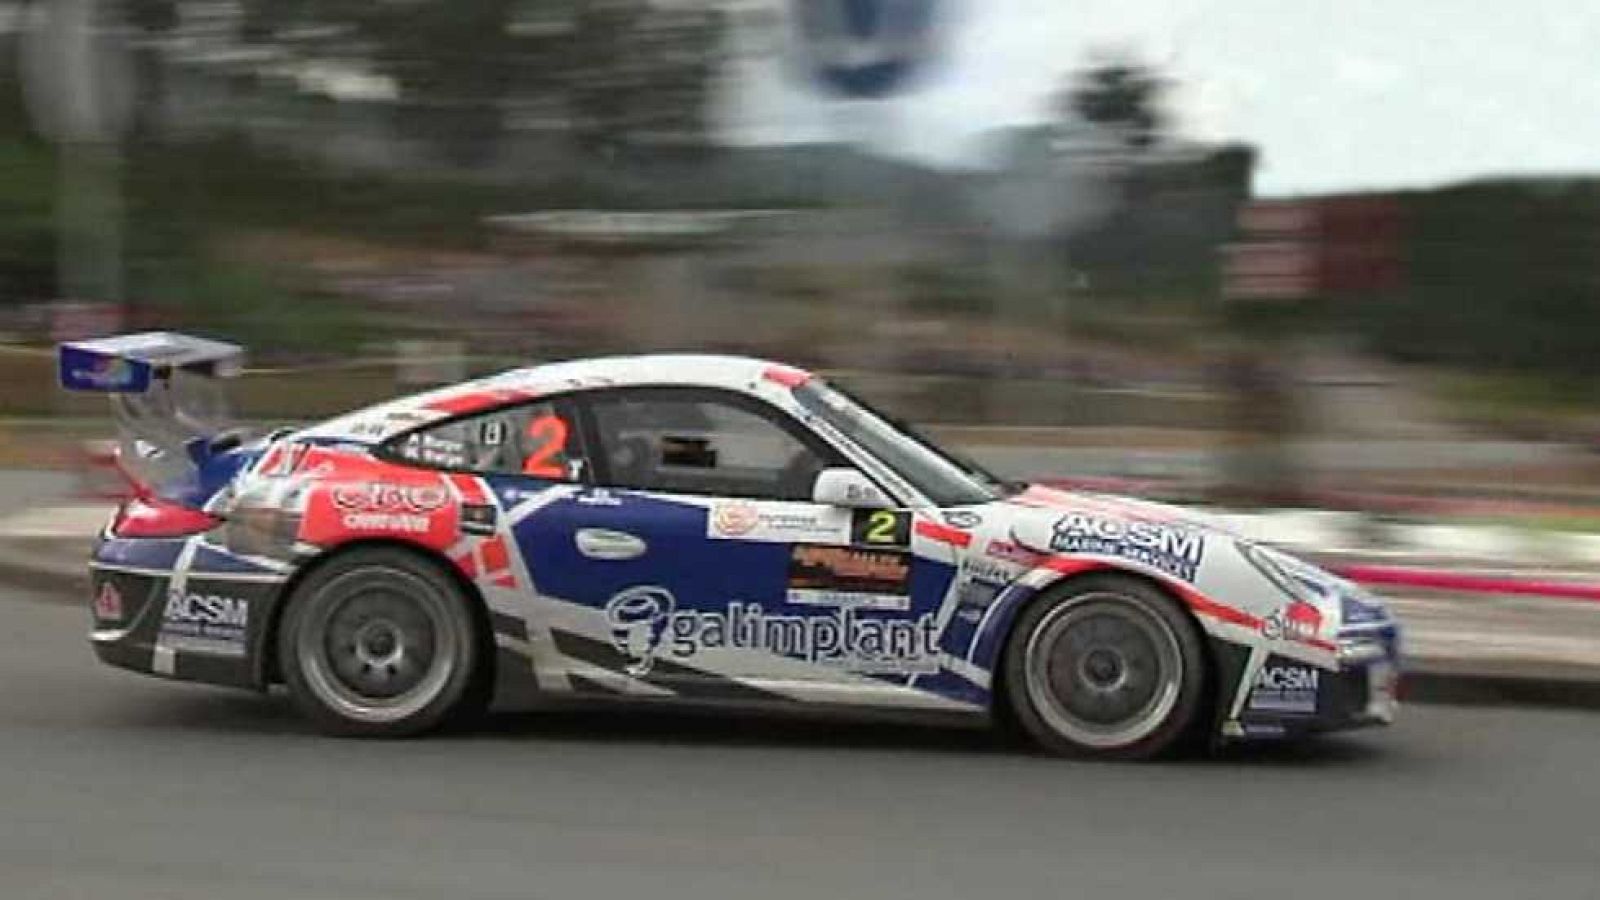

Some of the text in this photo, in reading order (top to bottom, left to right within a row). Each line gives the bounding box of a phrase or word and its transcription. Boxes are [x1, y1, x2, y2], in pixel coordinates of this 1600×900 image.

[521, 414, 567, 478] 2
[866, 511, 896, 542] 2
[1055, 512, 1207, 566] ACSM
[162, 593, 249, 626] ACSM
[672, 601, 941, 663] galimplant
[1253, 665, 1319, 691] ACSM
